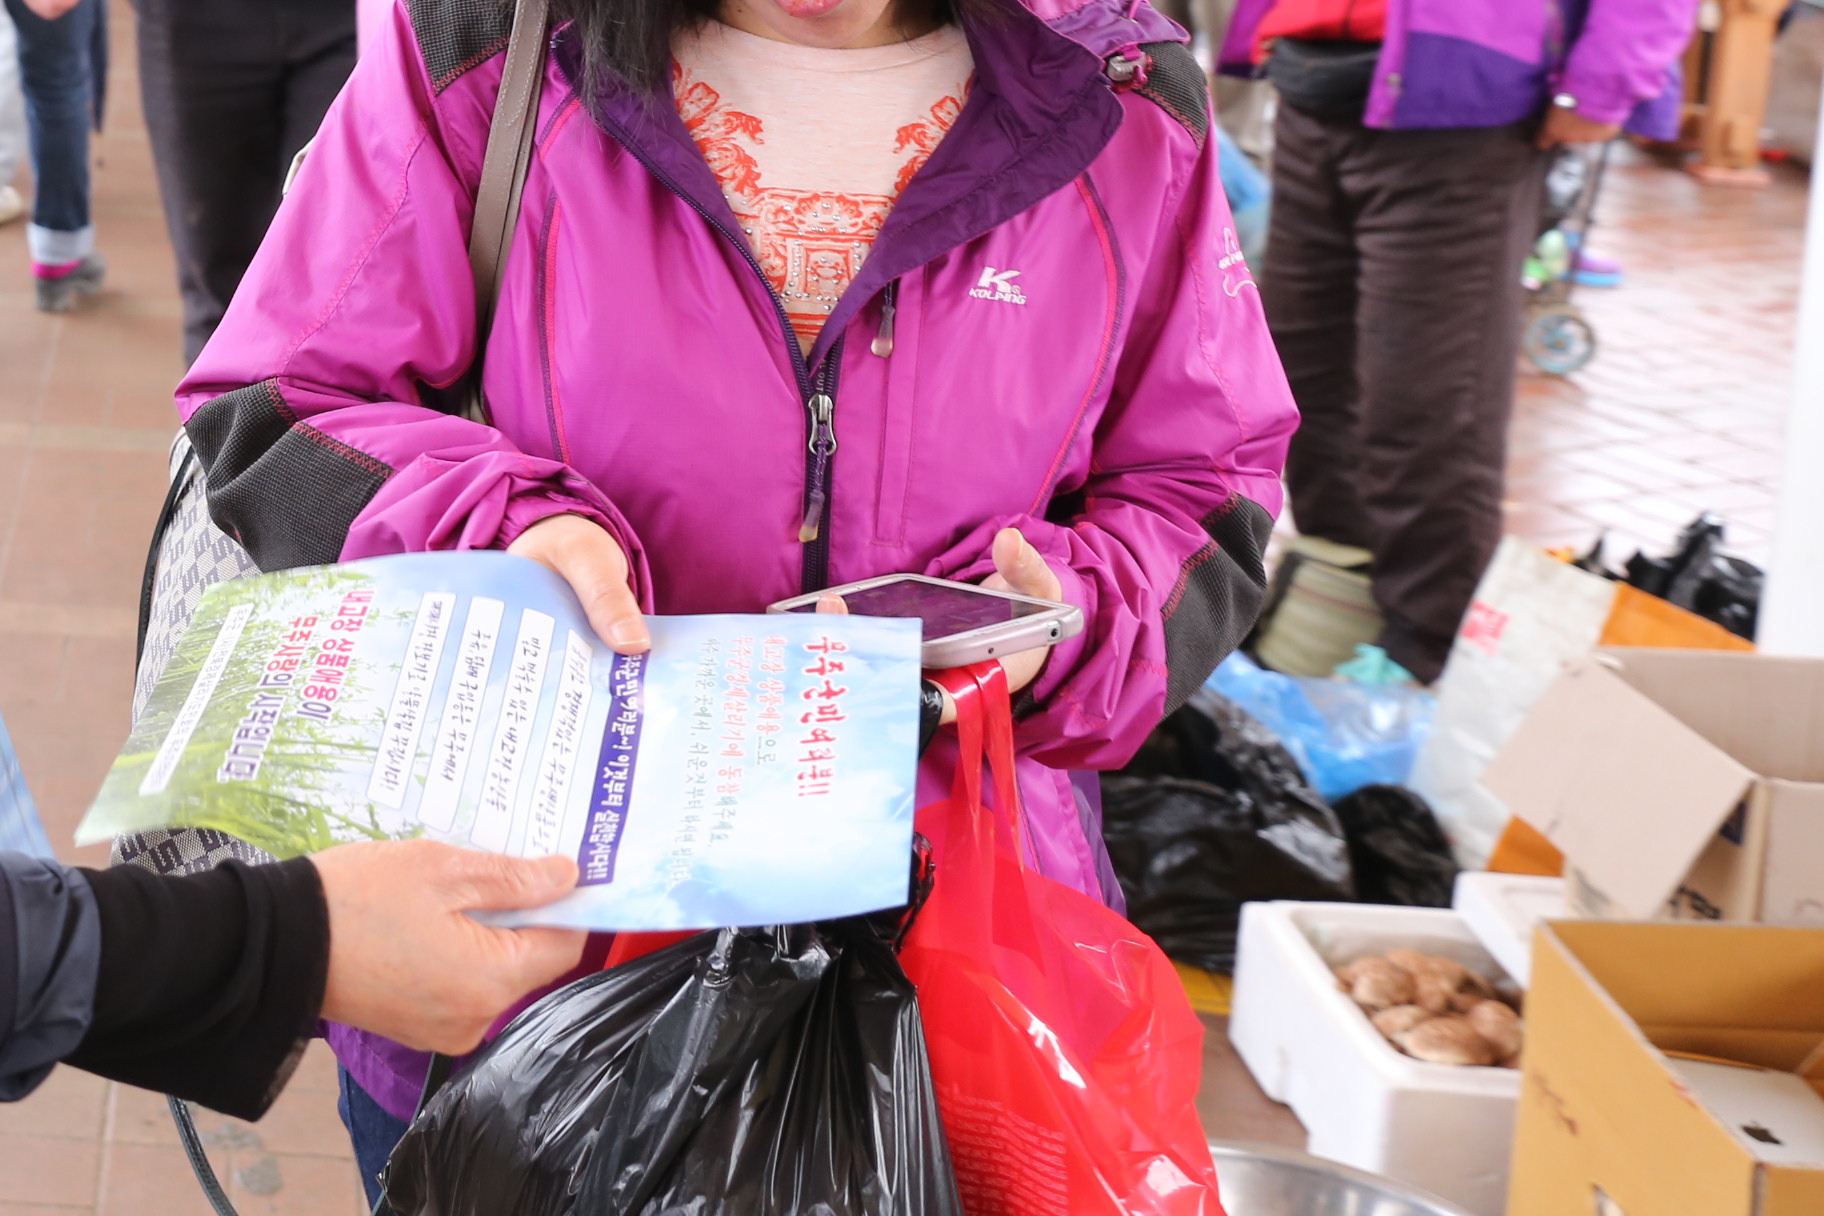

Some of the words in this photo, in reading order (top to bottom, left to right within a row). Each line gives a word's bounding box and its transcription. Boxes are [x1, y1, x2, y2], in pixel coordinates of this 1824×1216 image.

[969, 287, 1027, 305] KOLPING
[330, 590, 375, 632] 내고장
[259, 616, 319, 686] 무주사랑의
[296, 638, 355, 720] 상품애용이
[761, 635, 787, 672] 내고장
[719, 636, 753, 758] 무주군경제살리기에
[756, 680, 784, 766] 상품애용으로
[797, 636, 848, 797] 무주군민여러분!!
[601, 753, 631, 807] 이것부터
